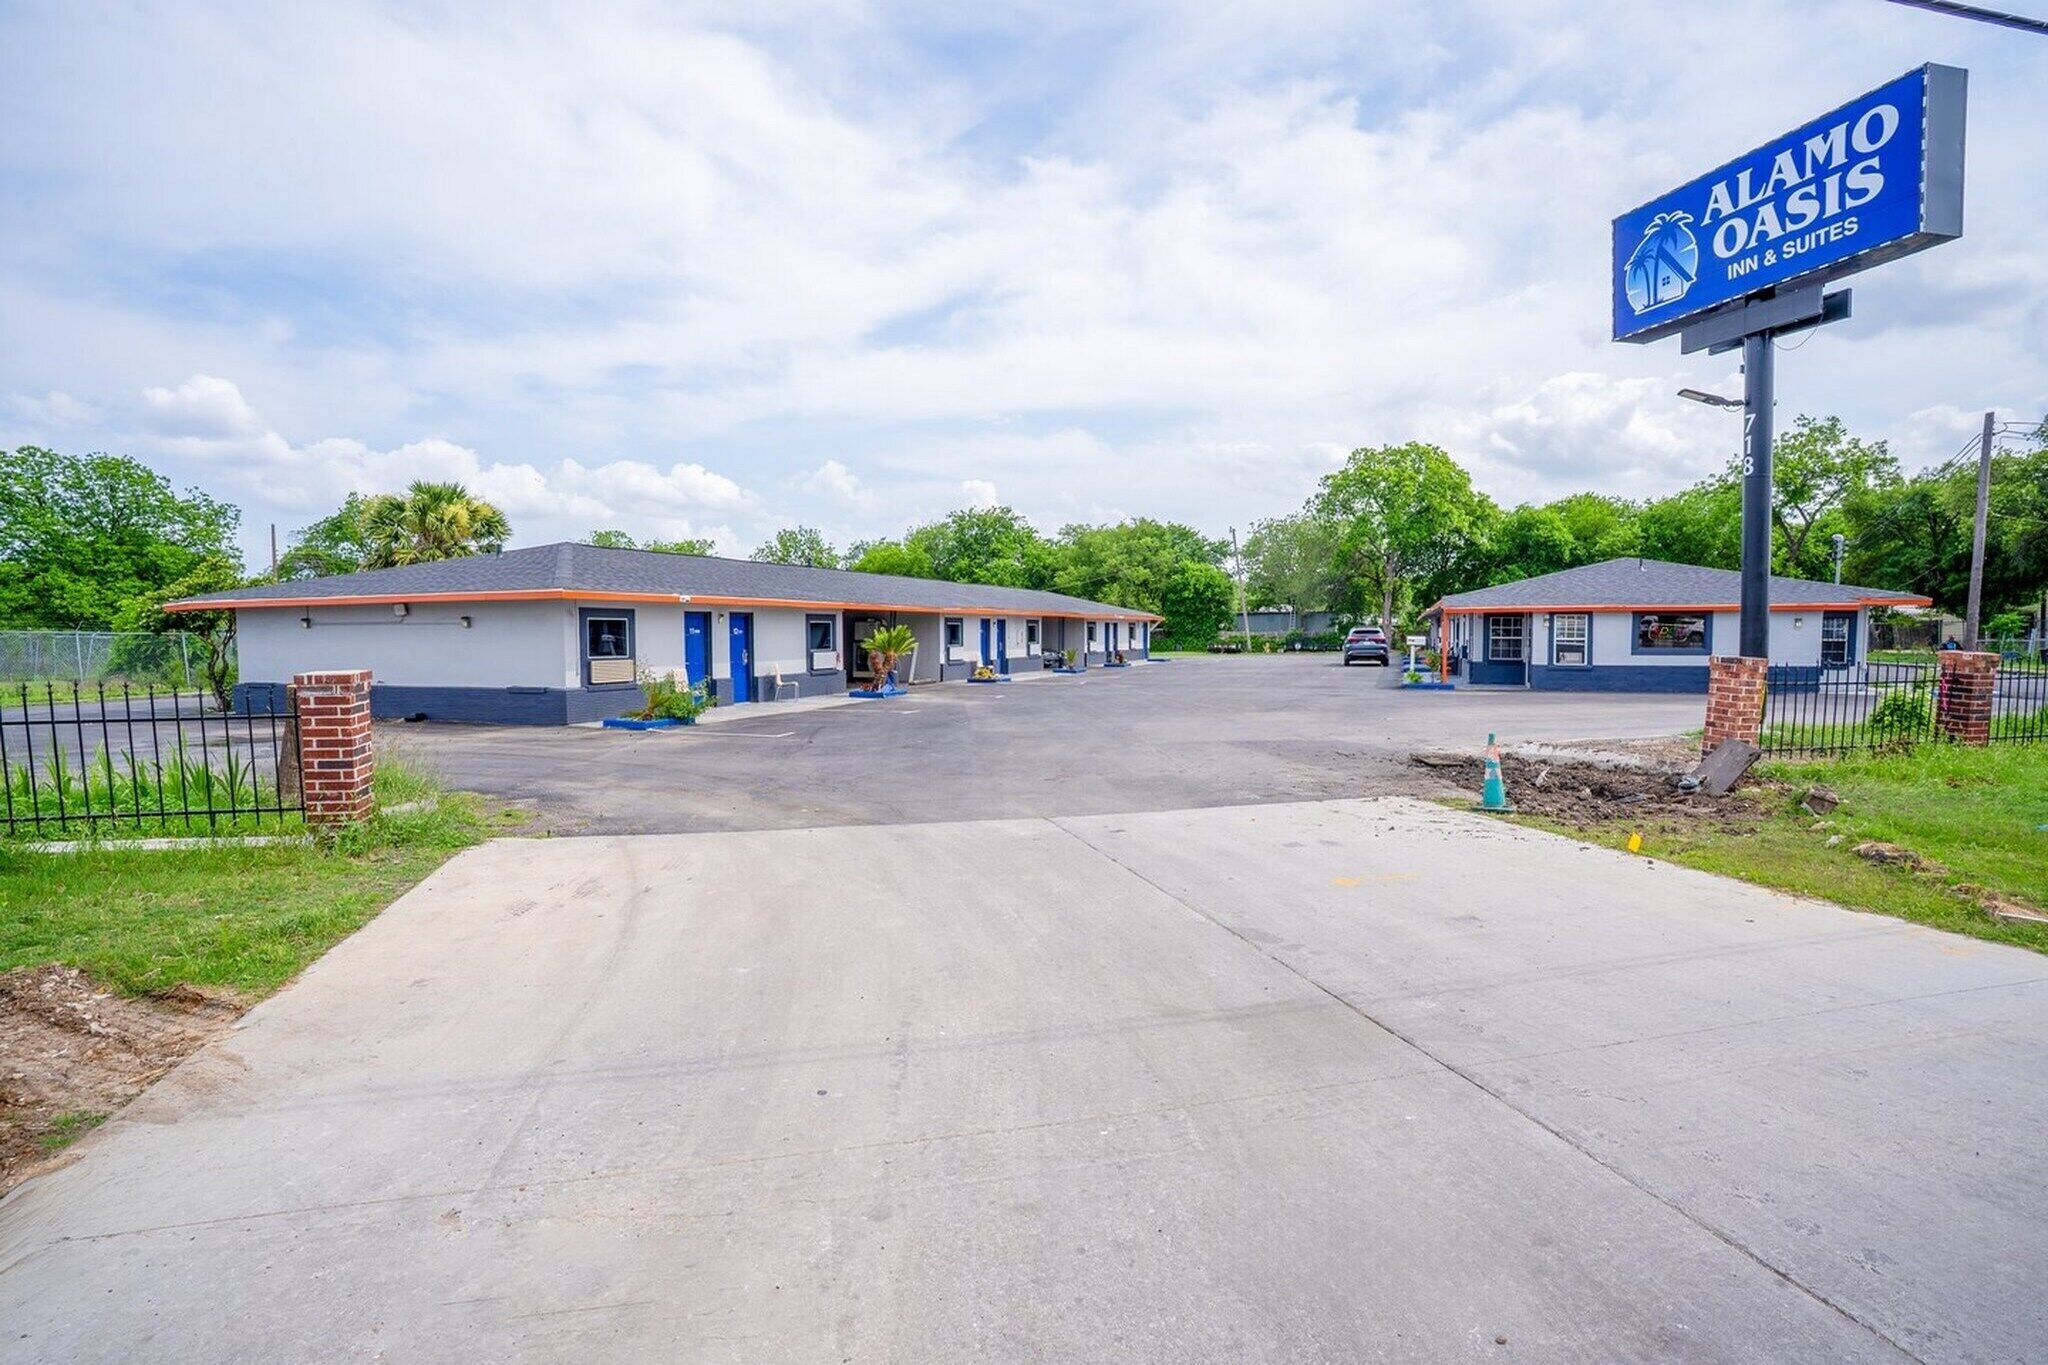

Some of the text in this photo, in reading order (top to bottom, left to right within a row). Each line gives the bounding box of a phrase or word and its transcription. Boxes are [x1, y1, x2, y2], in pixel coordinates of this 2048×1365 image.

[1701, 104, 1899, 226] ALAMO
[1713, 157, 1884, 258] OASIS
[1727, 218, 1858, 280] INN & SUITES
[1743, 413, 1756, 476] 718
